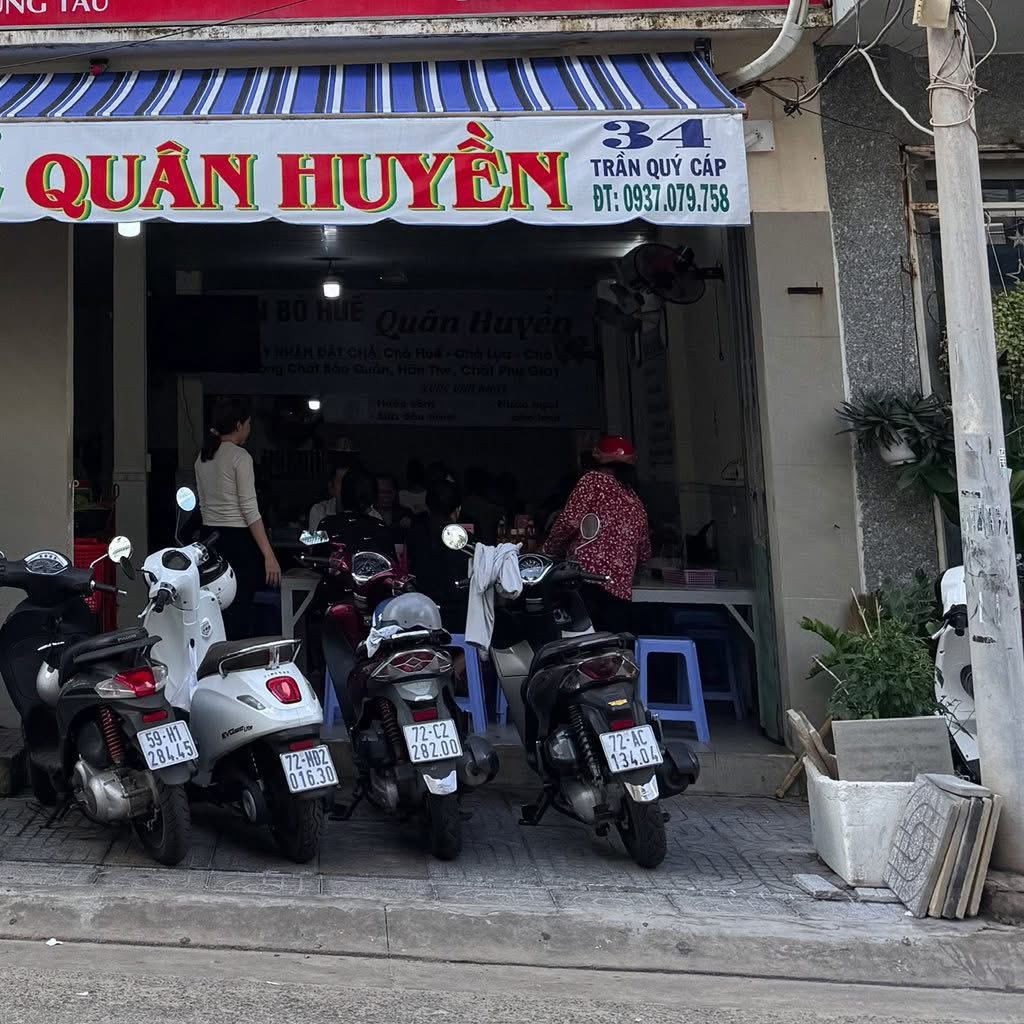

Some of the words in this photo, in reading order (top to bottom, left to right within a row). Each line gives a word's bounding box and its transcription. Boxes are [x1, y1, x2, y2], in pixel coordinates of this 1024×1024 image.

[601, 119, 712, 150] 34
[25, 140, 259, 221] QUÂN
[276, 121, 575, 213] HUYỀN
[590, 149, 643, 178] TRẦN
[646, 149, 682, 179] QUÝ
[690, 150, 727, 177] CÁP
[592, 187, 619, 213] ĐT:
[623, 183, 729, 213] 0937.079.758
[145, 724, 184, 748] 59-H1
[411, 722, 450, 742] 72-C2
[609, 728, 647, 750] 72-AC
[147, 740, 194, 768] 284.45
[411, 739, 460, 760] 282.00
[611, 747, 659, 771] 134.04
[289, 765, 336, 789] 016.30
